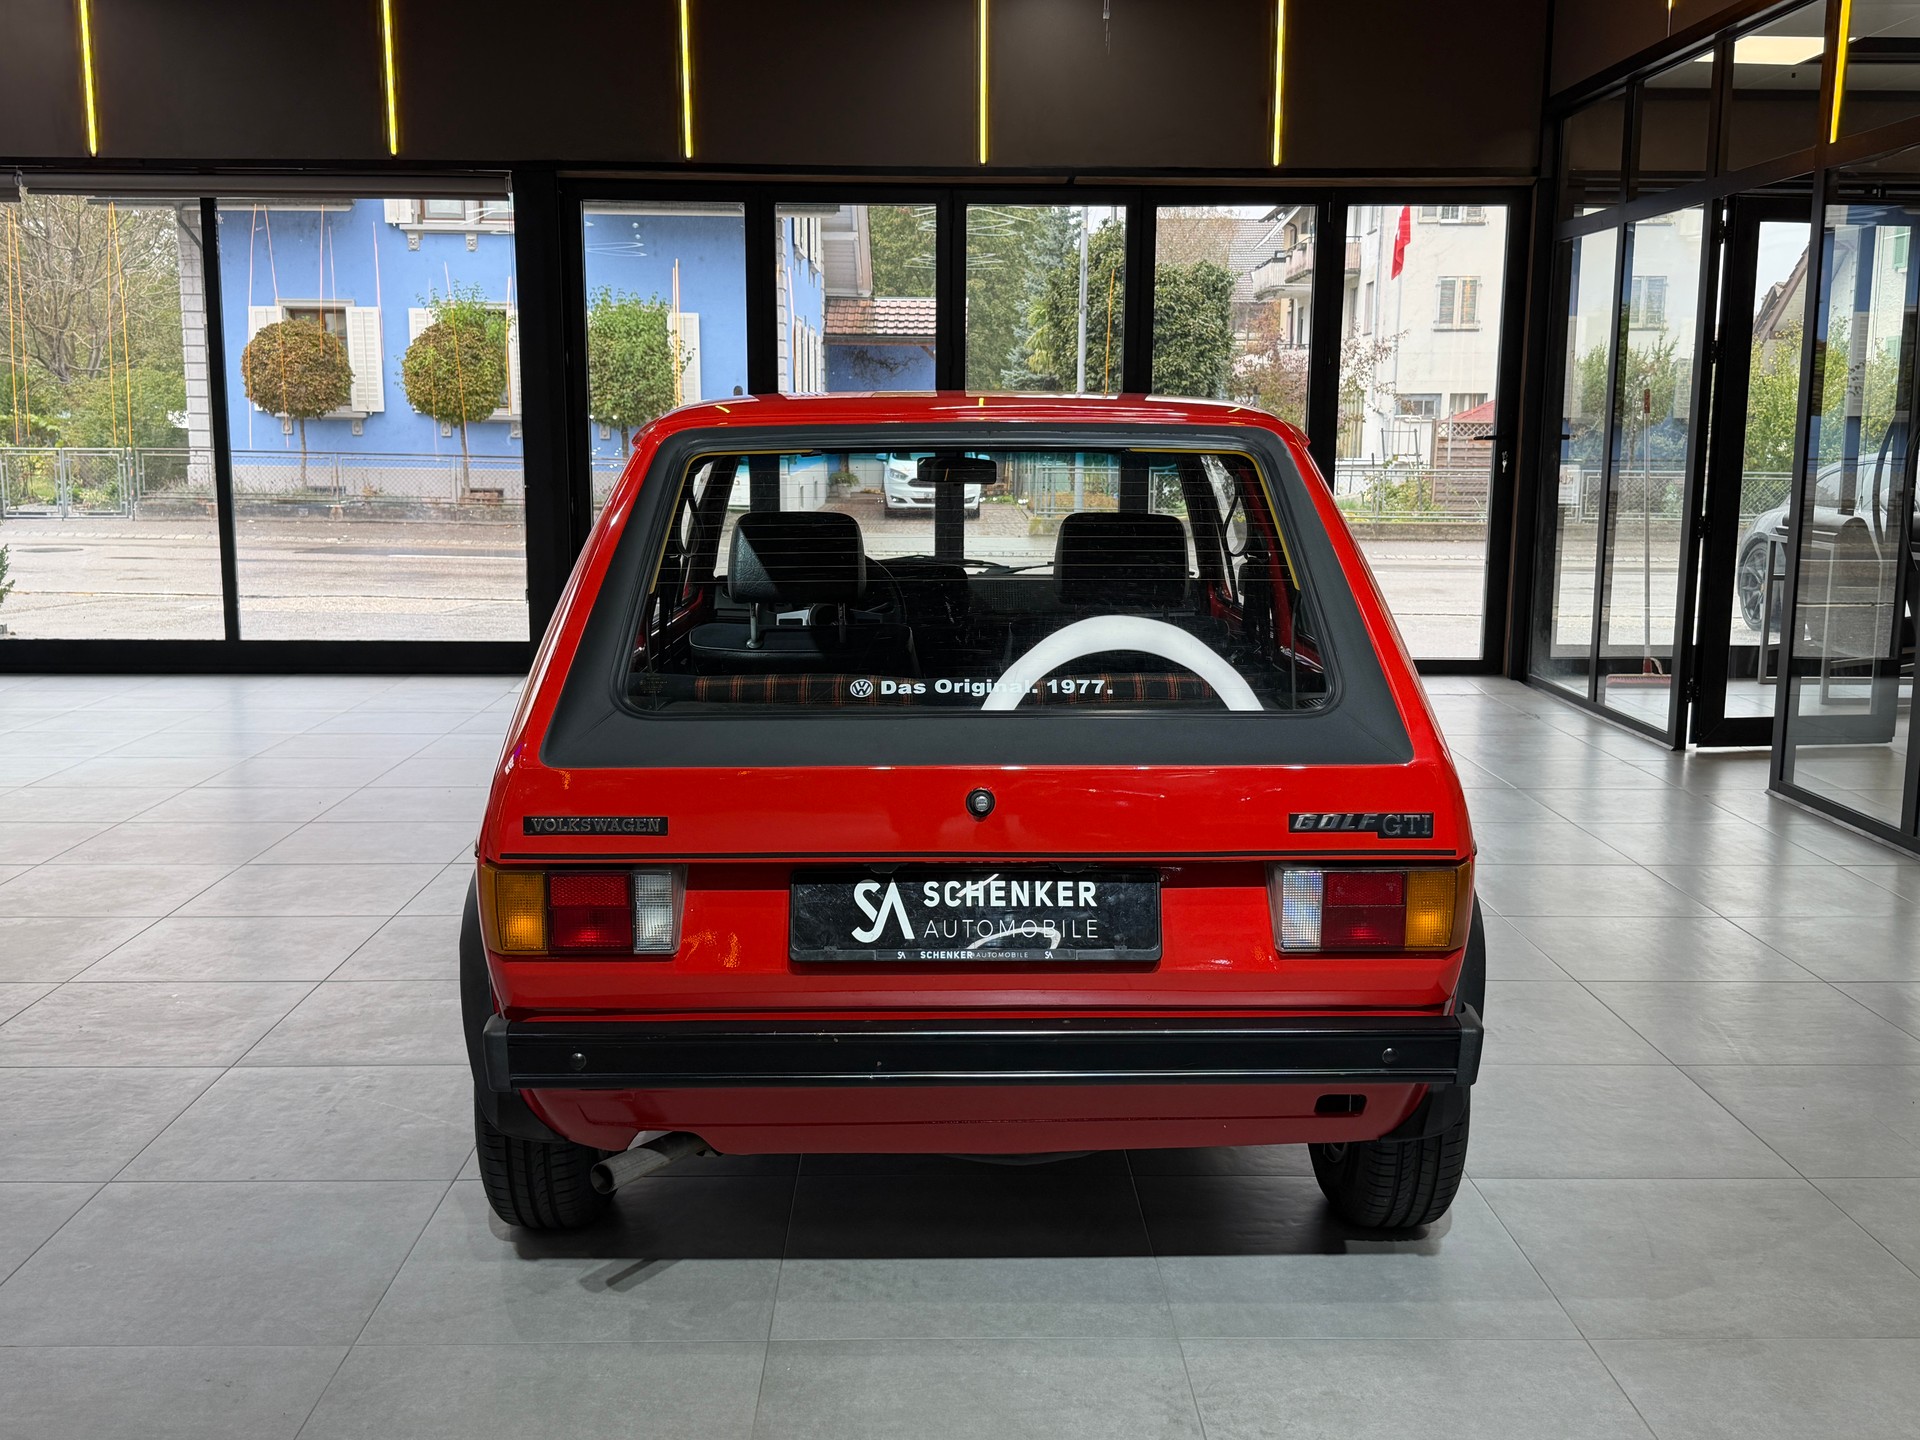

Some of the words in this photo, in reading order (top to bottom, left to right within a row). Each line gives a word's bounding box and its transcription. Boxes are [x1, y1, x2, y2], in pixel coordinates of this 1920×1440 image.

[880, 680, 927, 695] Das
[1046, 679, 1114, 695] 1977.
[530, 817, 661, 832] VOLKSWAGEN
[1292, 813, 1379, 830] GOLF
[1382, 814, 1431, 835] GTI
[922, 880, 1099, 907] SCHENKER
[923, 919, 1099, 939] AUTOMOBILE
[920, 951, 973, 960] SCHENKER
[976, 951, 1029, 959] AUTOMOBILE
